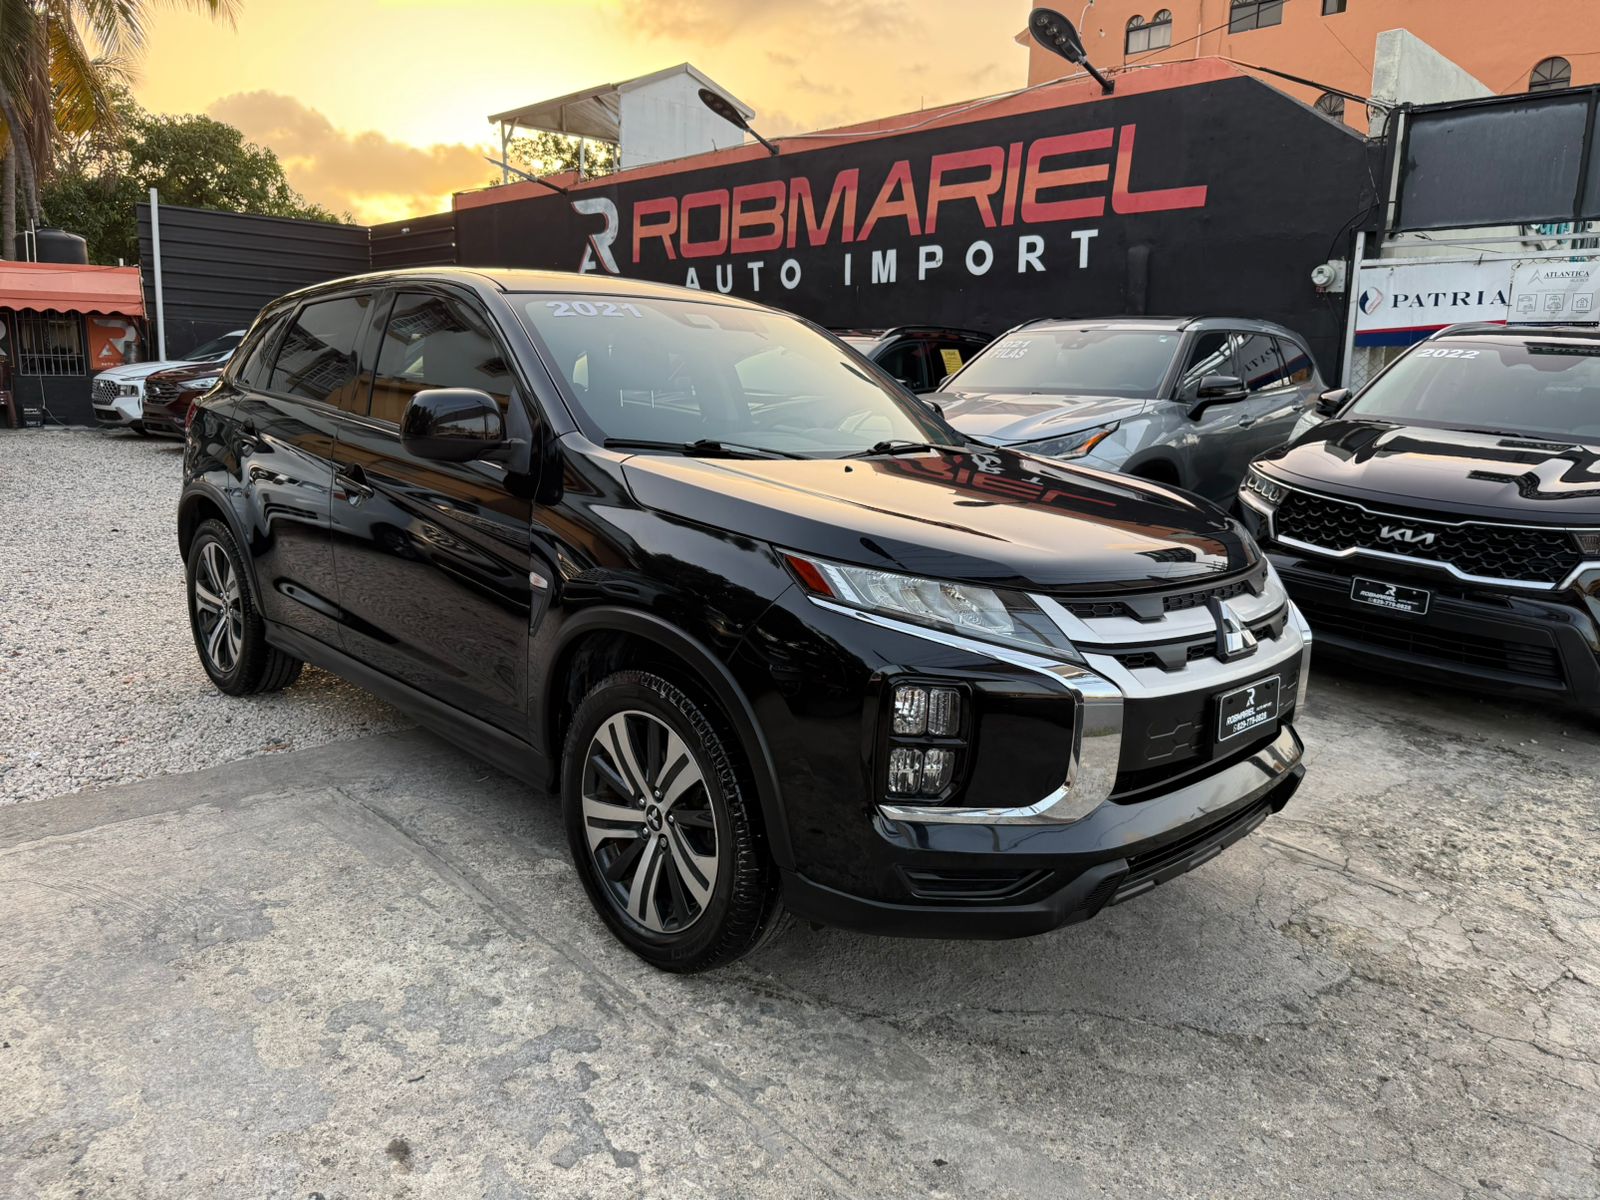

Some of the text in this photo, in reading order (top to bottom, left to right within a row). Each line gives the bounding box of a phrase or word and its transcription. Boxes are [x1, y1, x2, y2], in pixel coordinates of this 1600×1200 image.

[631, 123, 1208, 264] ROBMARIEL
[684, 228, 1099, 294] AUTO IMPORT
[546, 300, 643, 318] 2021
[1391, 289, 1509, 309] PATRIA
[1415, 348, 1481, 360] 2022
[1380, 525, 1435, 546] KIA
